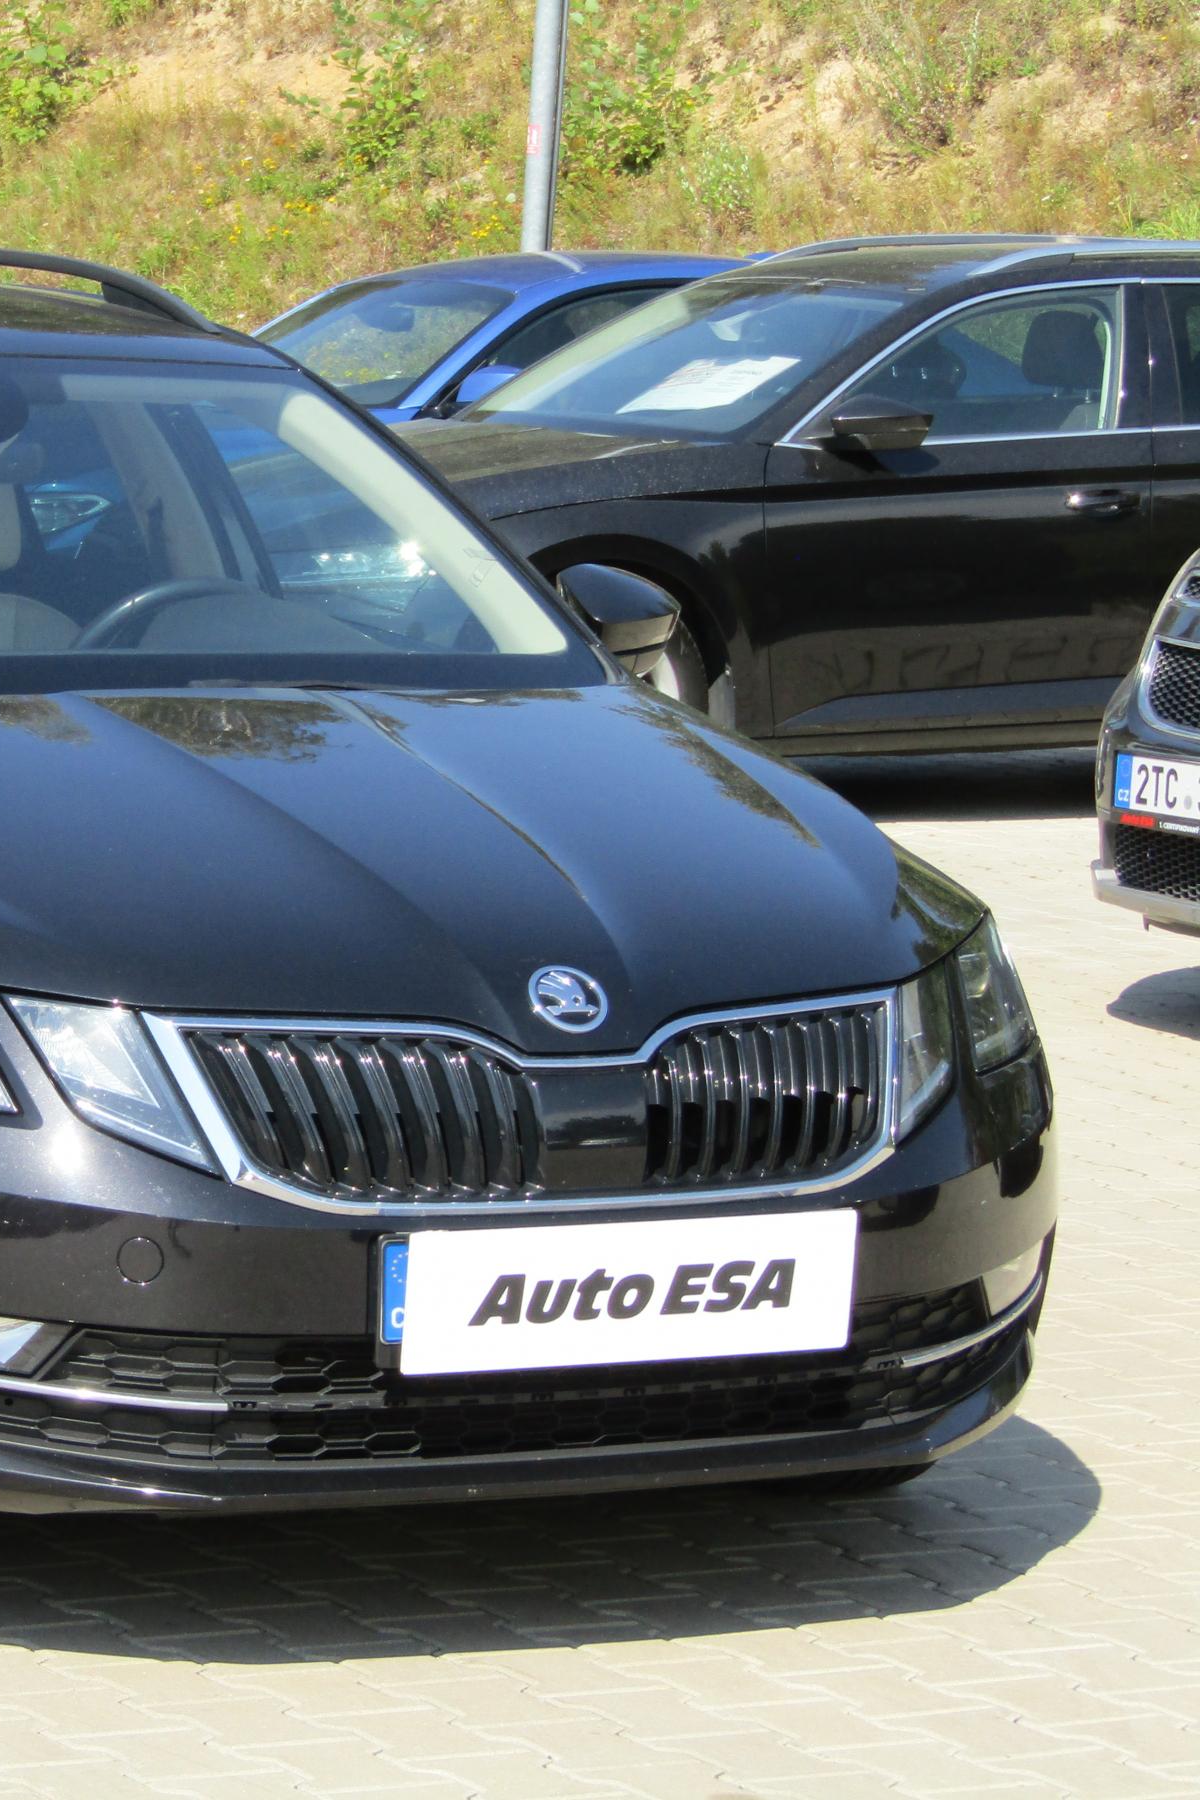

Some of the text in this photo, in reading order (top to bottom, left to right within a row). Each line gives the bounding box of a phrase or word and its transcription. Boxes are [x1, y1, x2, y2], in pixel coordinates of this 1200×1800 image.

[1117, 788, 1130, 802] CZ
[1135, 764, 1178, 809] 2TC
[467, 1258, 796, 1327] Auto ESA
[391, 1306, 405, 1329] C
